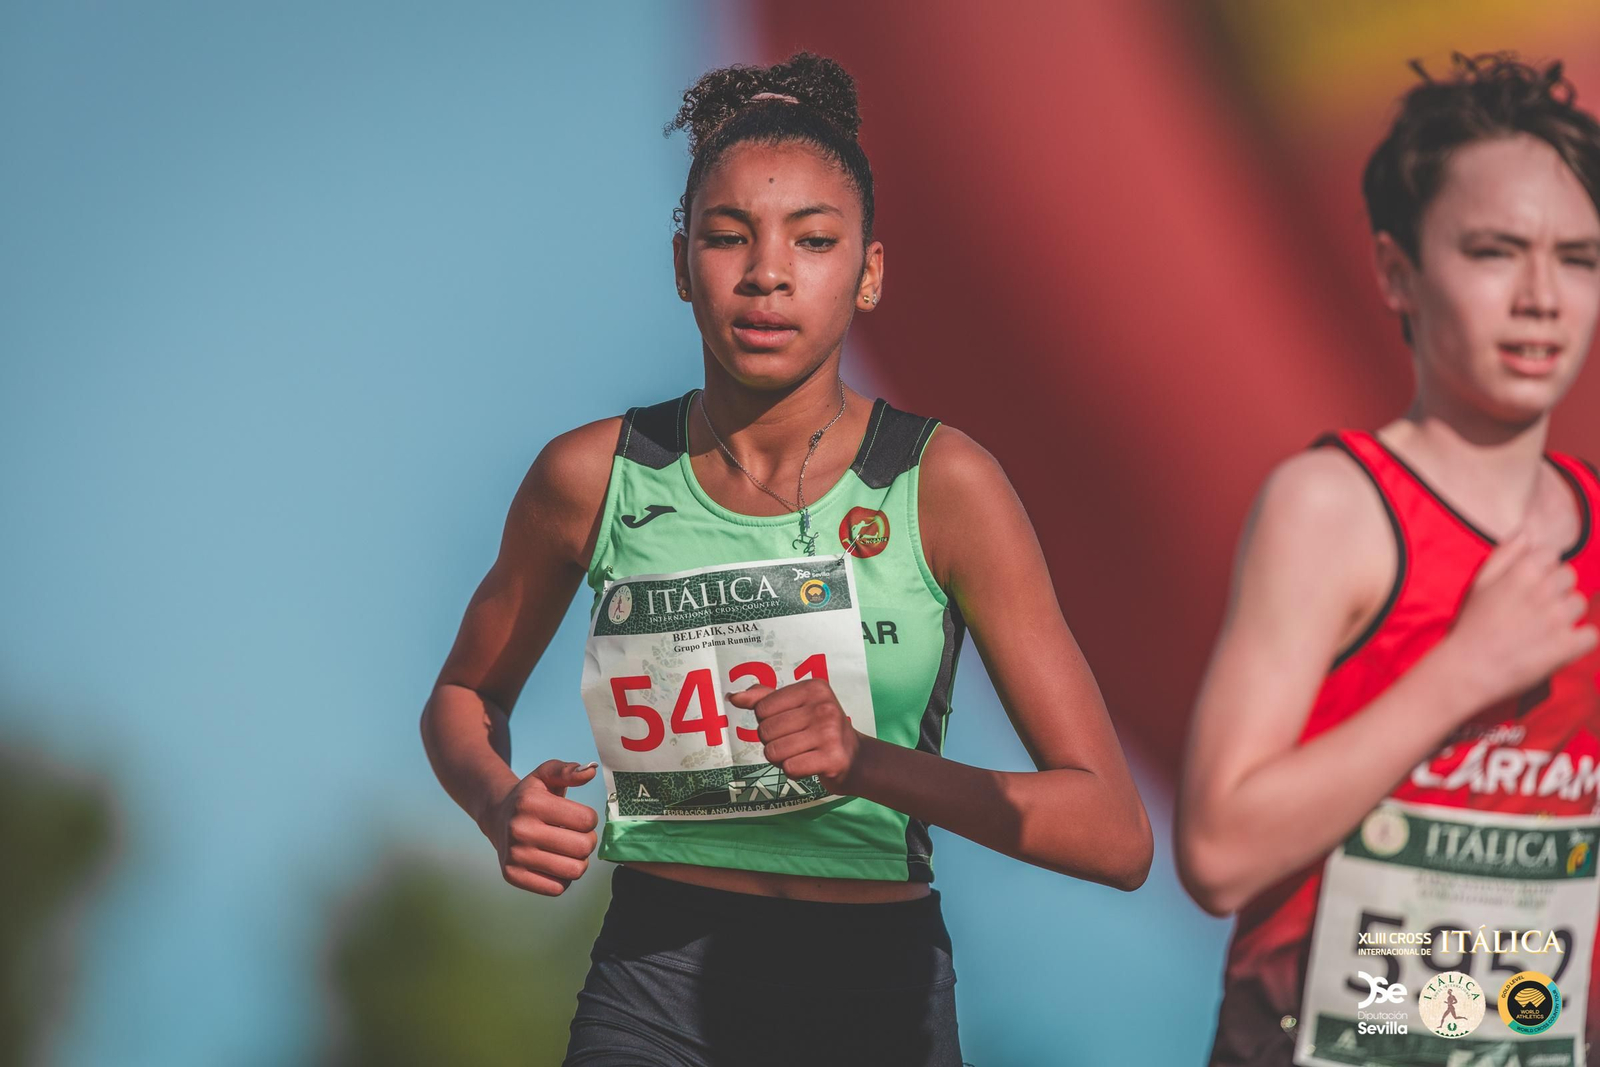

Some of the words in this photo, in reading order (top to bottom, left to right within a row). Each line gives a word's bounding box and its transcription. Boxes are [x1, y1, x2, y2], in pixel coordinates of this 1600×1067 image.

[647, 575, 780, 615] ITÁLICA
[650, 608, 712, 623] INTERNATIONAL
[715, 605, 739, 614] CROSS
[742, 600, 780, 611] COUNTRY
[672, 626, 726, 643] BELFAIK,
[728, 622, 759, 635] SARA
[673, 643, 701, 653] Grupo
[702, 637, 726, 649] Palma
[728, 634, 762, 646] Running
[663, 806, 708, 817] FEDERACIÓN
[711, 805, 753, 816] ANDALUZA
[756, 803, 767, 812] DE
[769, 795, 816, 810] ATLETISMO
